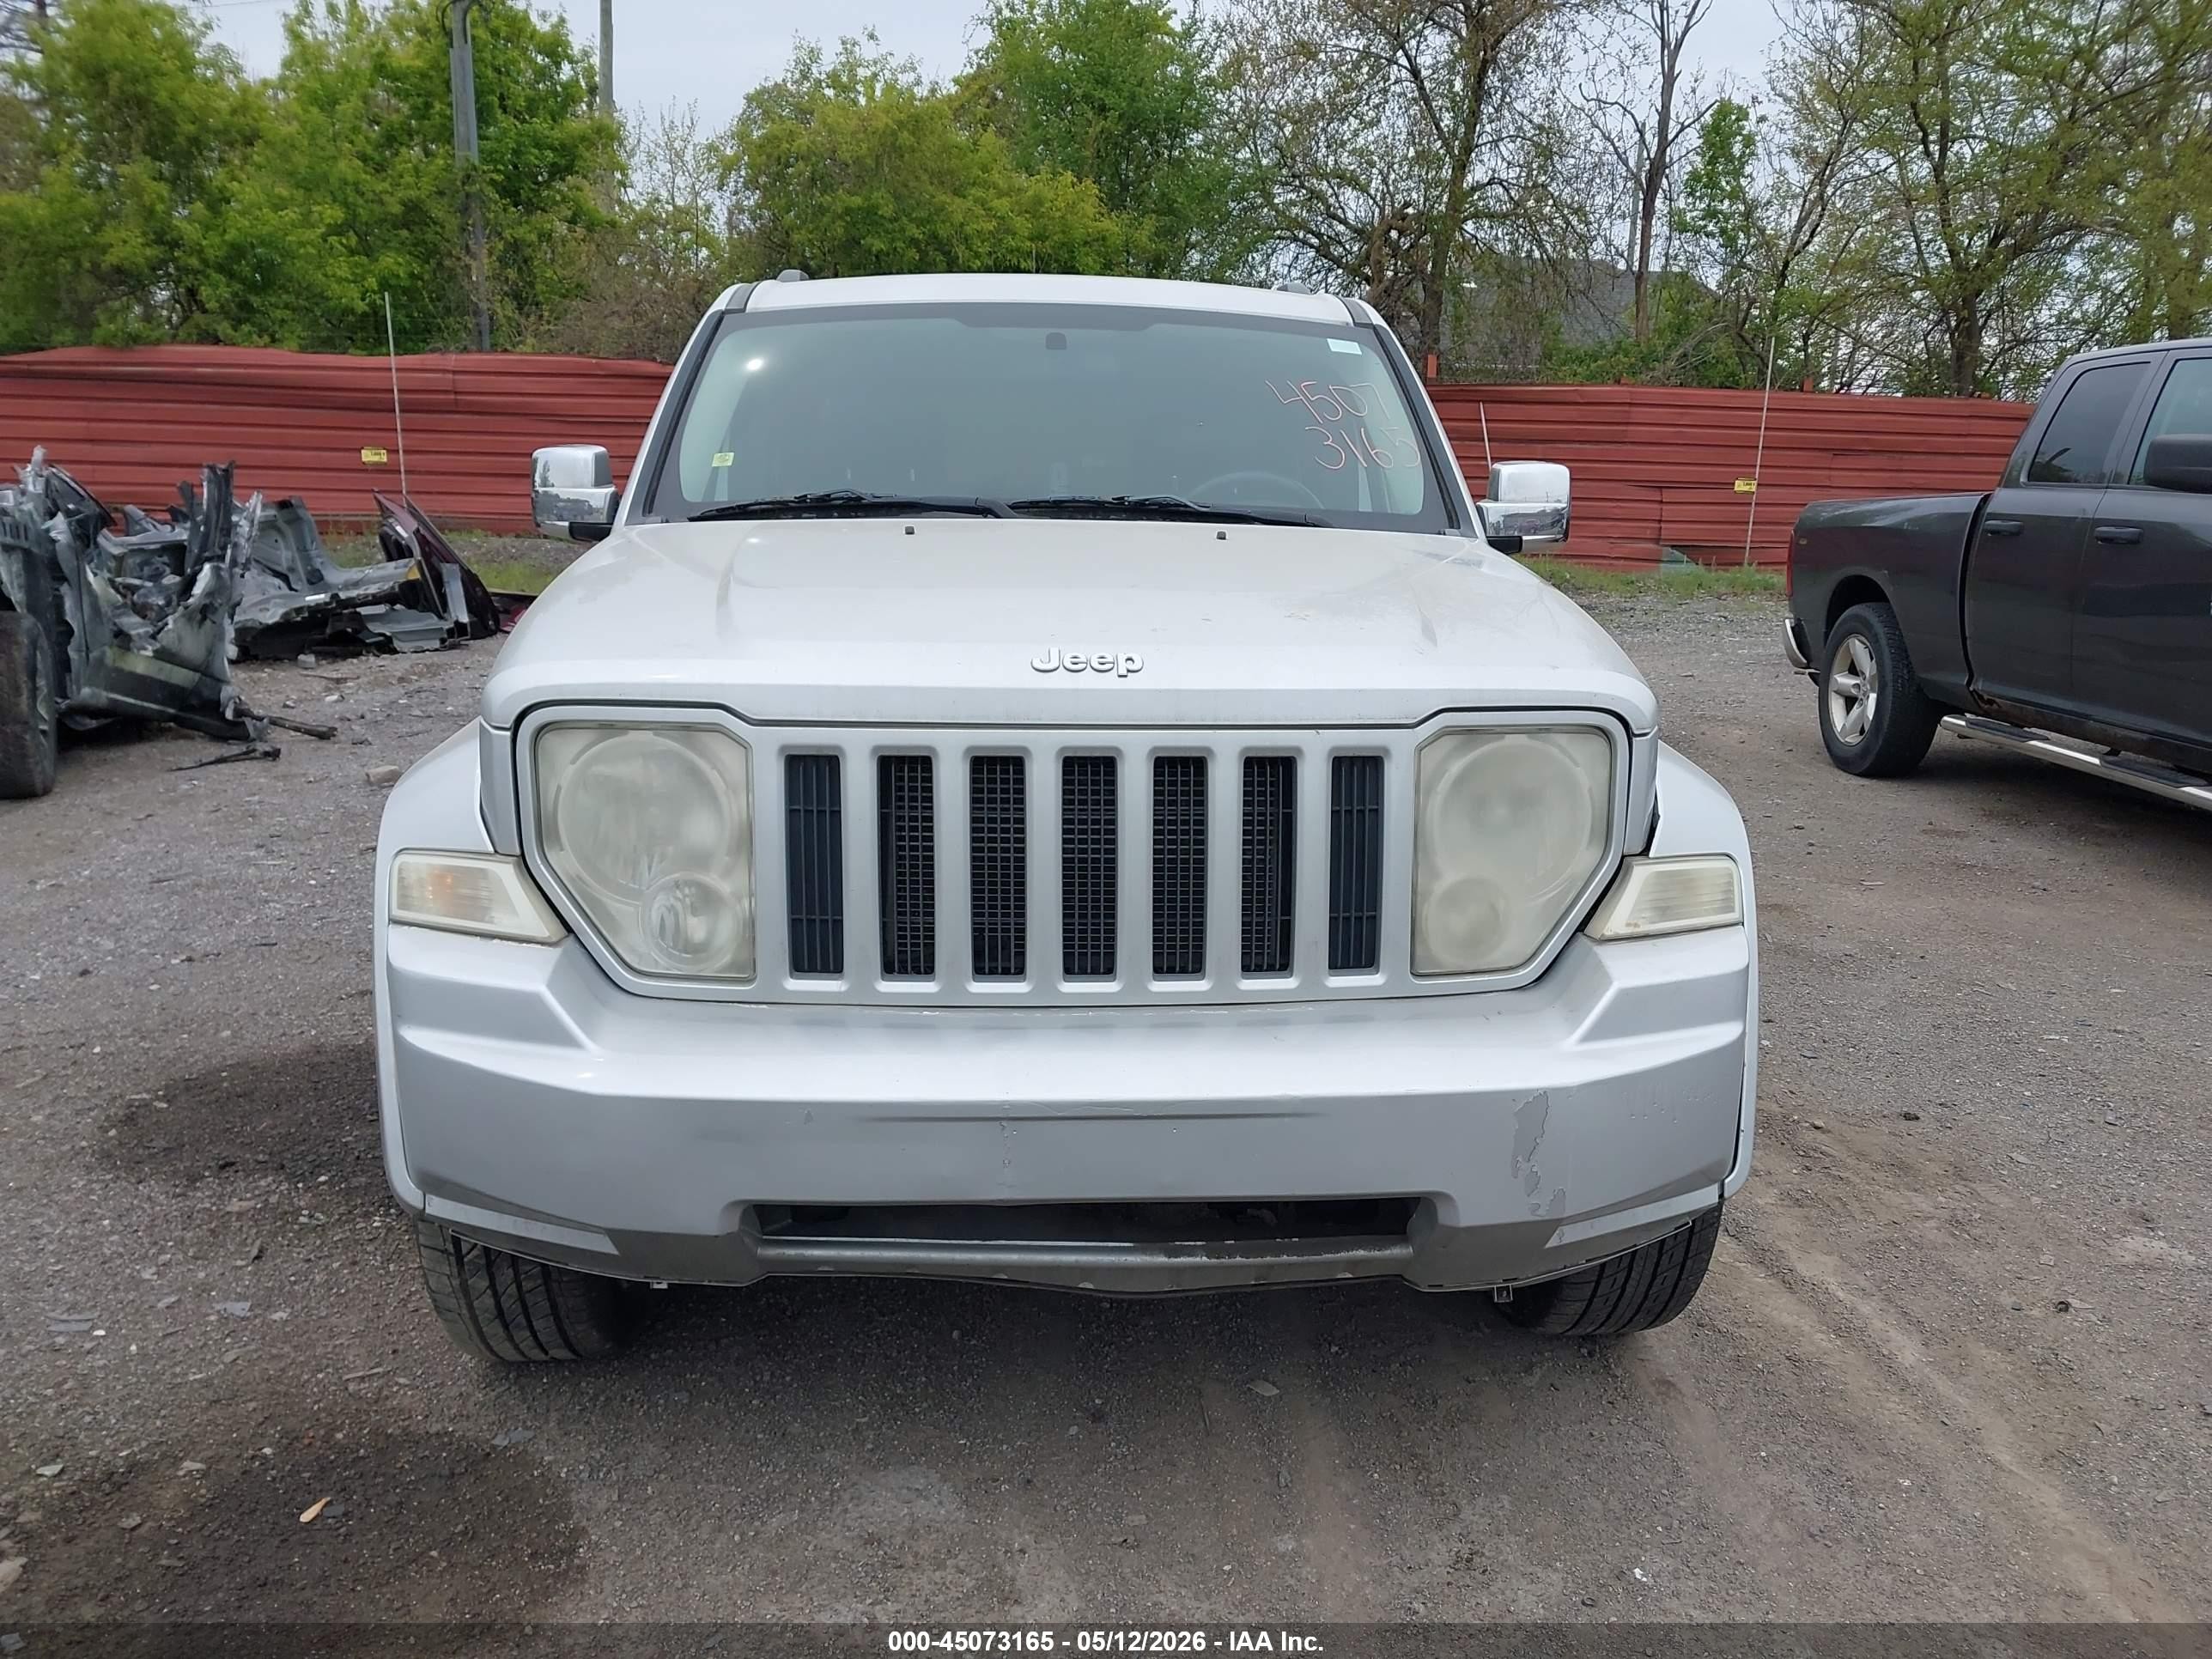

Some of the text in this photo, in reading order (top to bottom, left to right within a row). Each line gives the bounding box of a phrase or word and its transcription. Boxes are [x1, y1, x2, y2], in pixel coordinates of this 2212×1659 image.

[1264, 380, 1391, 424] 4507
[1304, 426, 1421, 470] 3165
[1030, 646, 1144, 678] Jeep
